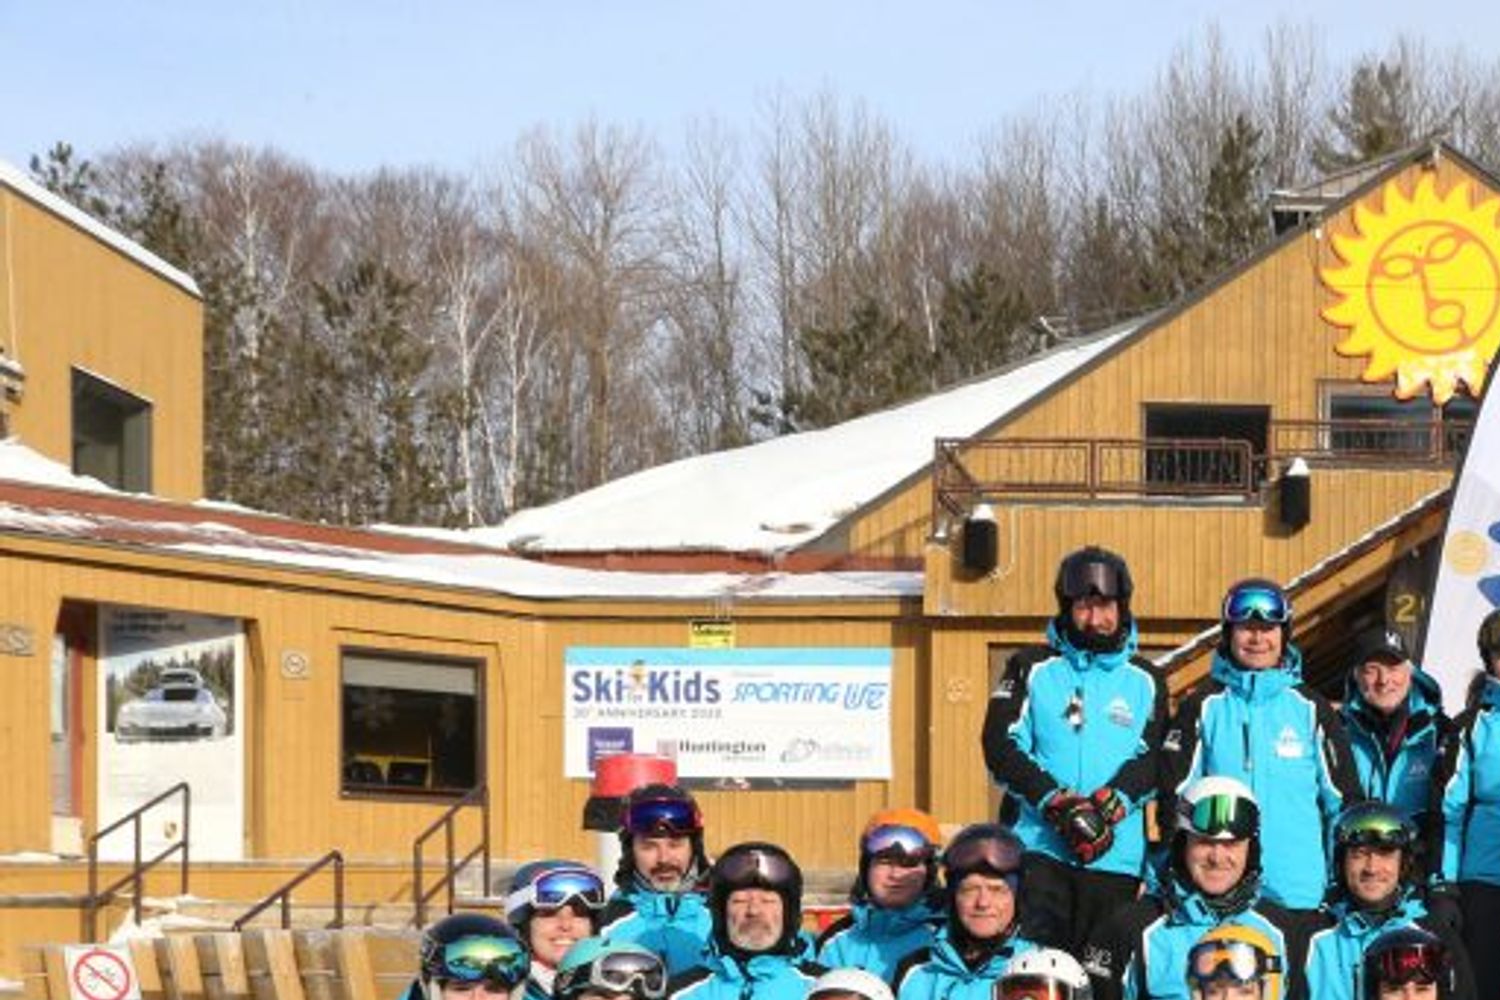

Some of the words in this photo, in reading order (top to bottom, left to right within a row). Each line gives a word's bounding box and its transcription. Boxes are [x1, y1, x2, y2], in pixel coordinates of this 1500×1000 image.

[573, 671, 623, 703] Ski
[648, 670, 721, 703] Kids
[679, 738, 767, 754] Huntington
